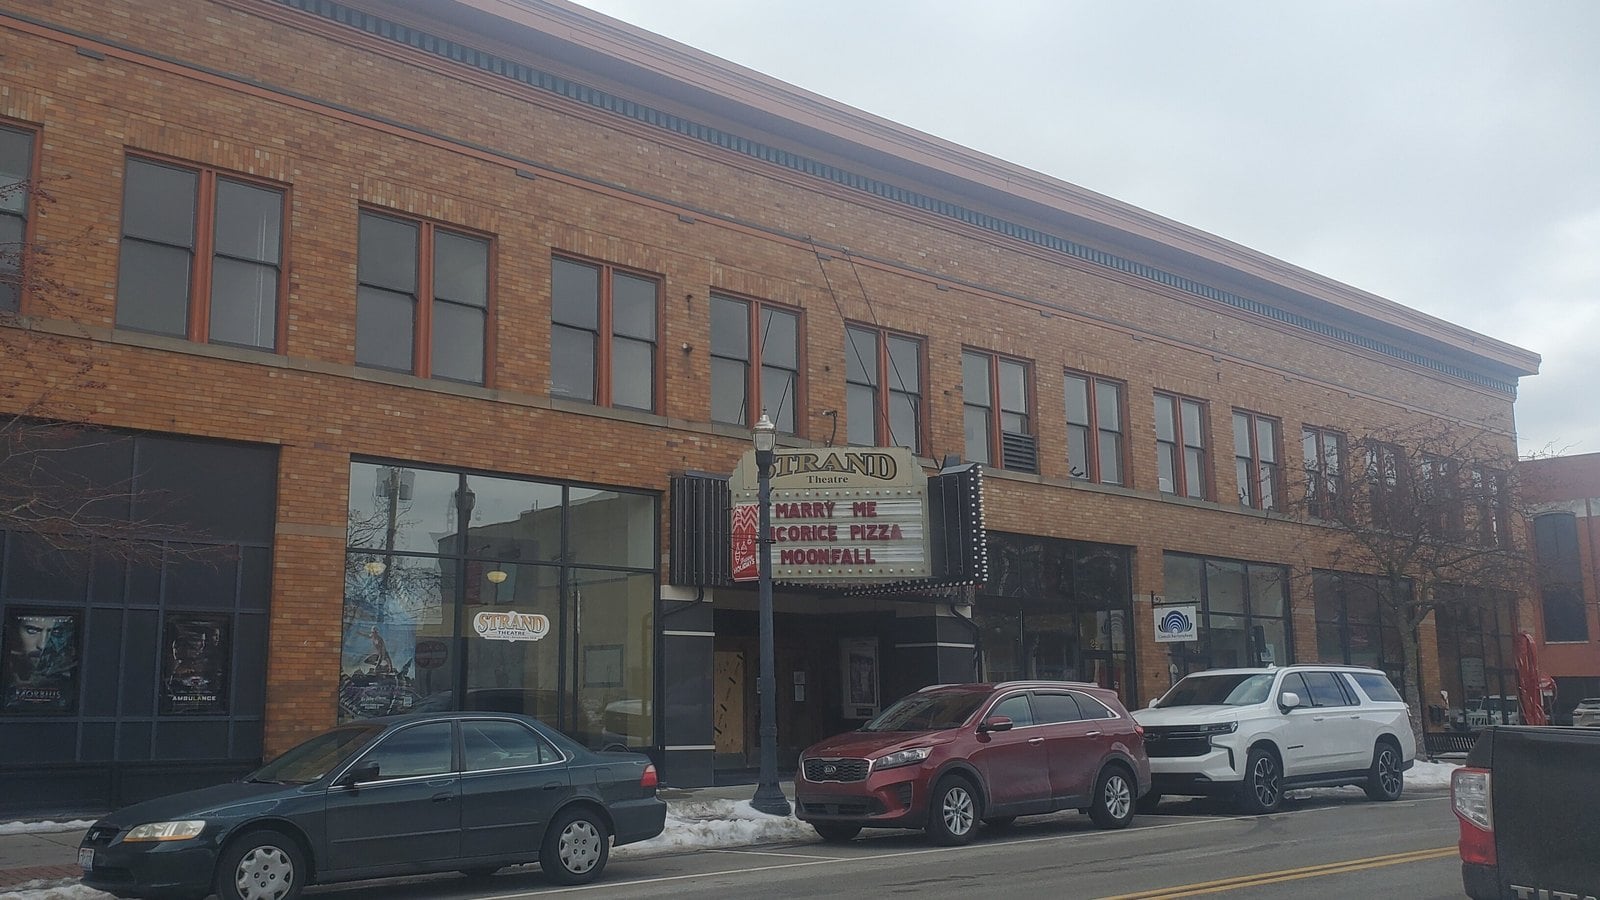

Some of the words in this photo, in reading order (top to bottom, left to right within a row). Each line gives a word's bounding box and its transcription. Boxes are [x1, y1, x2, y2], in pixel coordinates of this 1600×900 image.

[807, 475, 849, 484] Theatre
[775, 502, 836, 519] MARRY
[852, 502, 877, 518] ME
[770, 525, 838, 542] ICORICE
[850, 524, 902, 541] PIZZA
[780, 548, 876, 566] MOONFALL
[479, 614, 544, 633] STRAND
